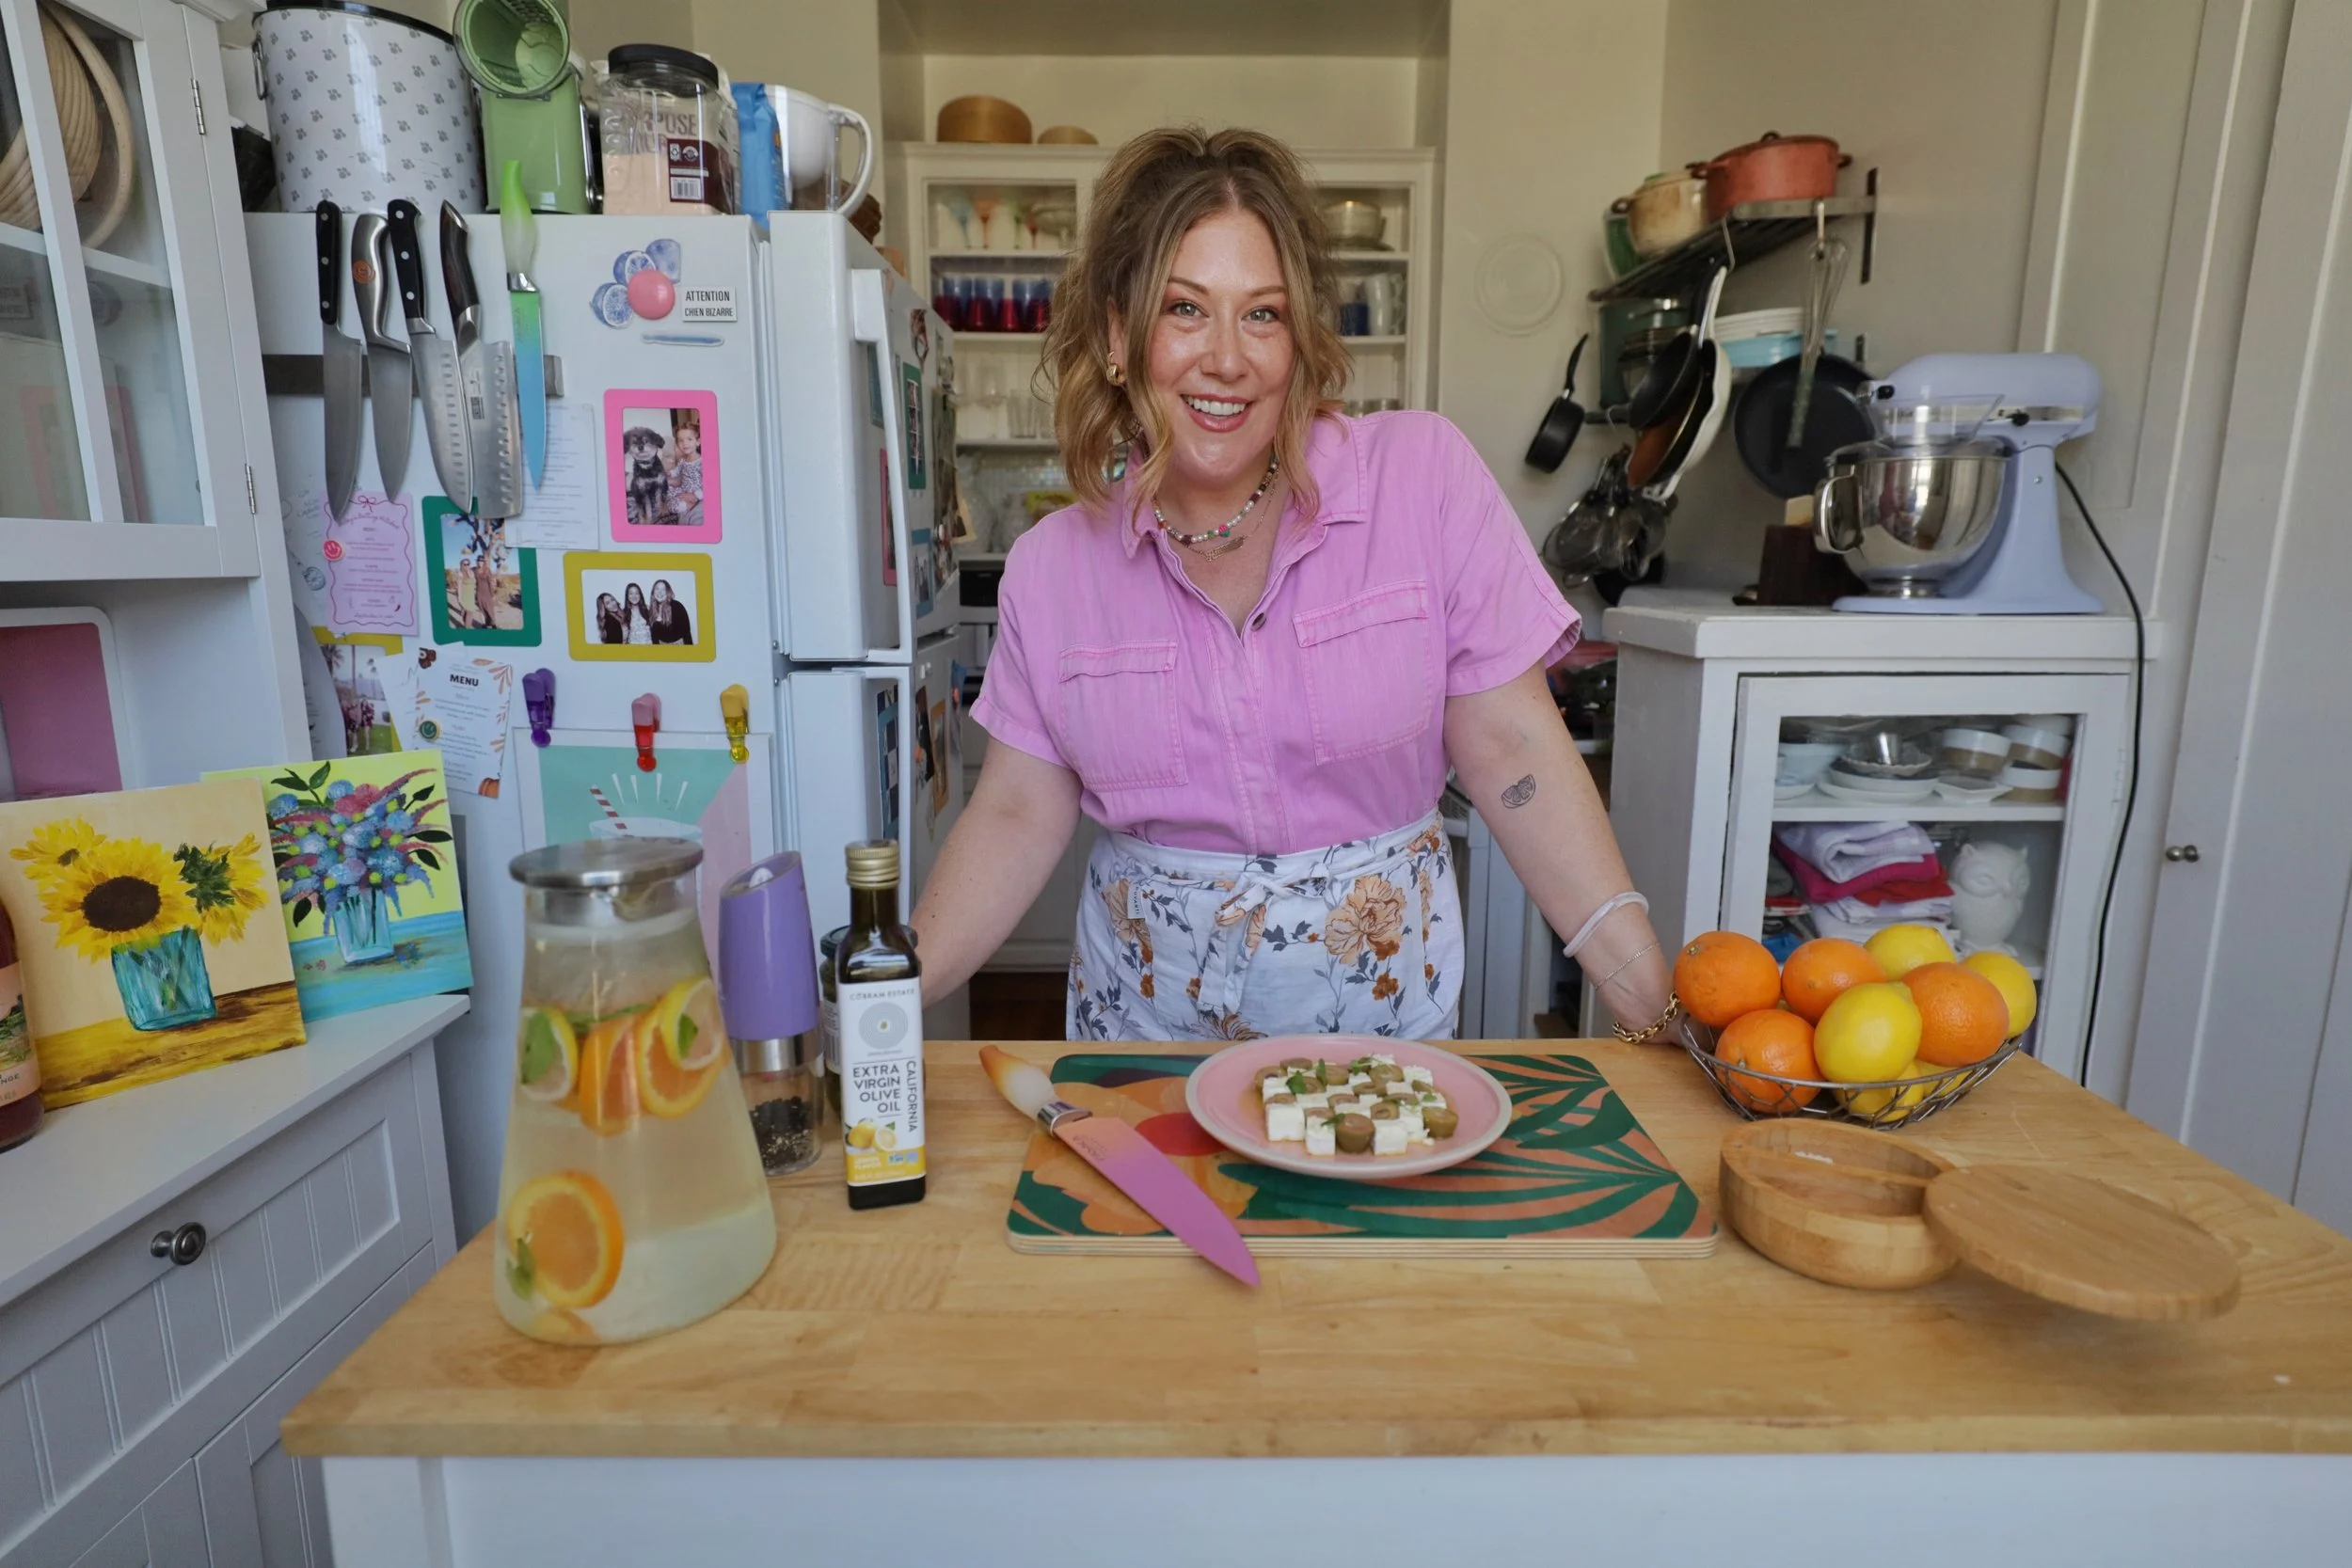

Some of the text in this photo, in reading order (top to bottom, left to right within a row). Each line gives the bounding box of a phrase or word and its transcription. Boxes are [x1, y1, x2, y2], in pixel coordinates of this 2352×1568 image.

[685, 291, 730, 302] ATTENTION
[684, 308, 734, 317] CHIEN BIZARRE
[449, 673, 479, 687] MENU
[852, 1065, 899, 1078] EXTRA
[853, 1076, 900, 1090] VIRGIN
[859, 1088, 900, 1102] OLIVE
[906, 1060, 918, 1132] CALIFORNIA
[877, 1101, 900, 1113] OIL
